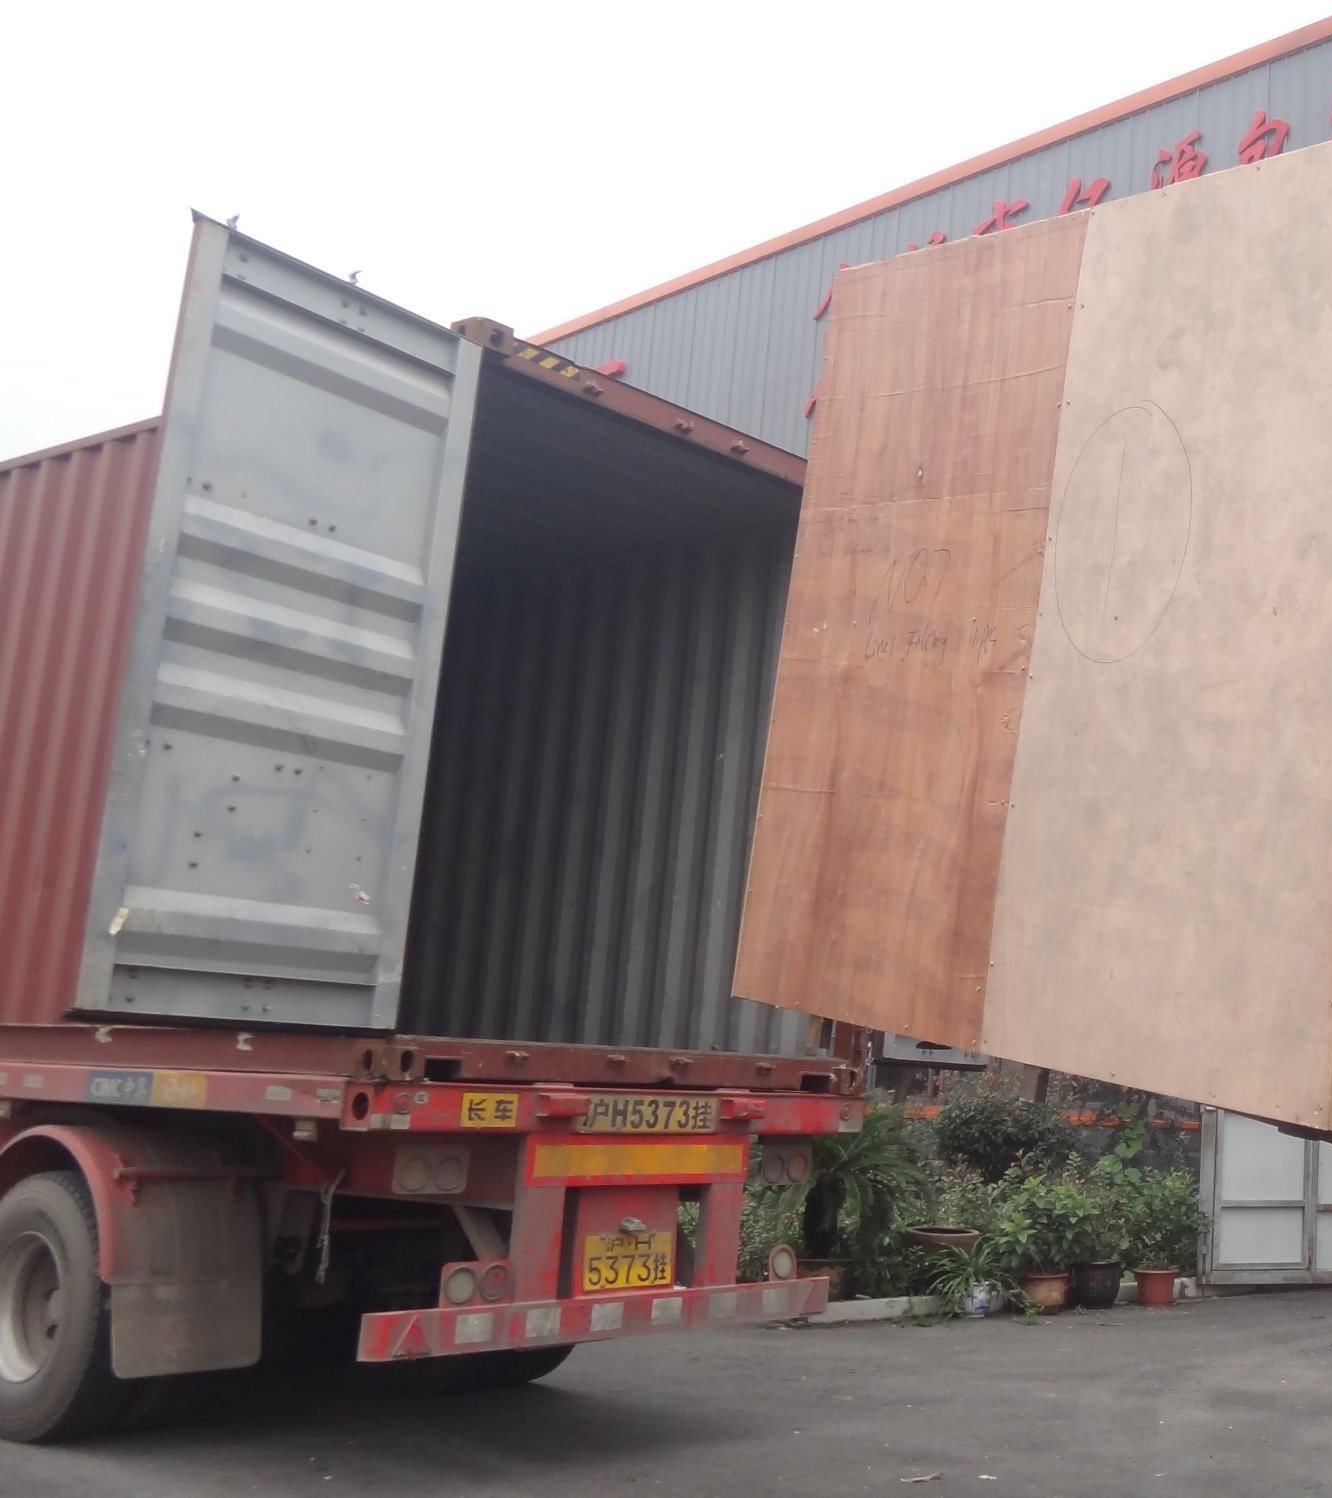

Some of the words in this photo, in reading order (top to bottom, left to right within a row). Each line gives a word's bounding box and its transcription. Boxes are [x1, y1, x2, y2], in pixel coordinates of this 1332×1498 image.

[467, 1098, 513, 1122] 长车
[582, 1098, 712, 1130] 沪H5373挂
[588, 1252, 667, 1286] 5373挂
